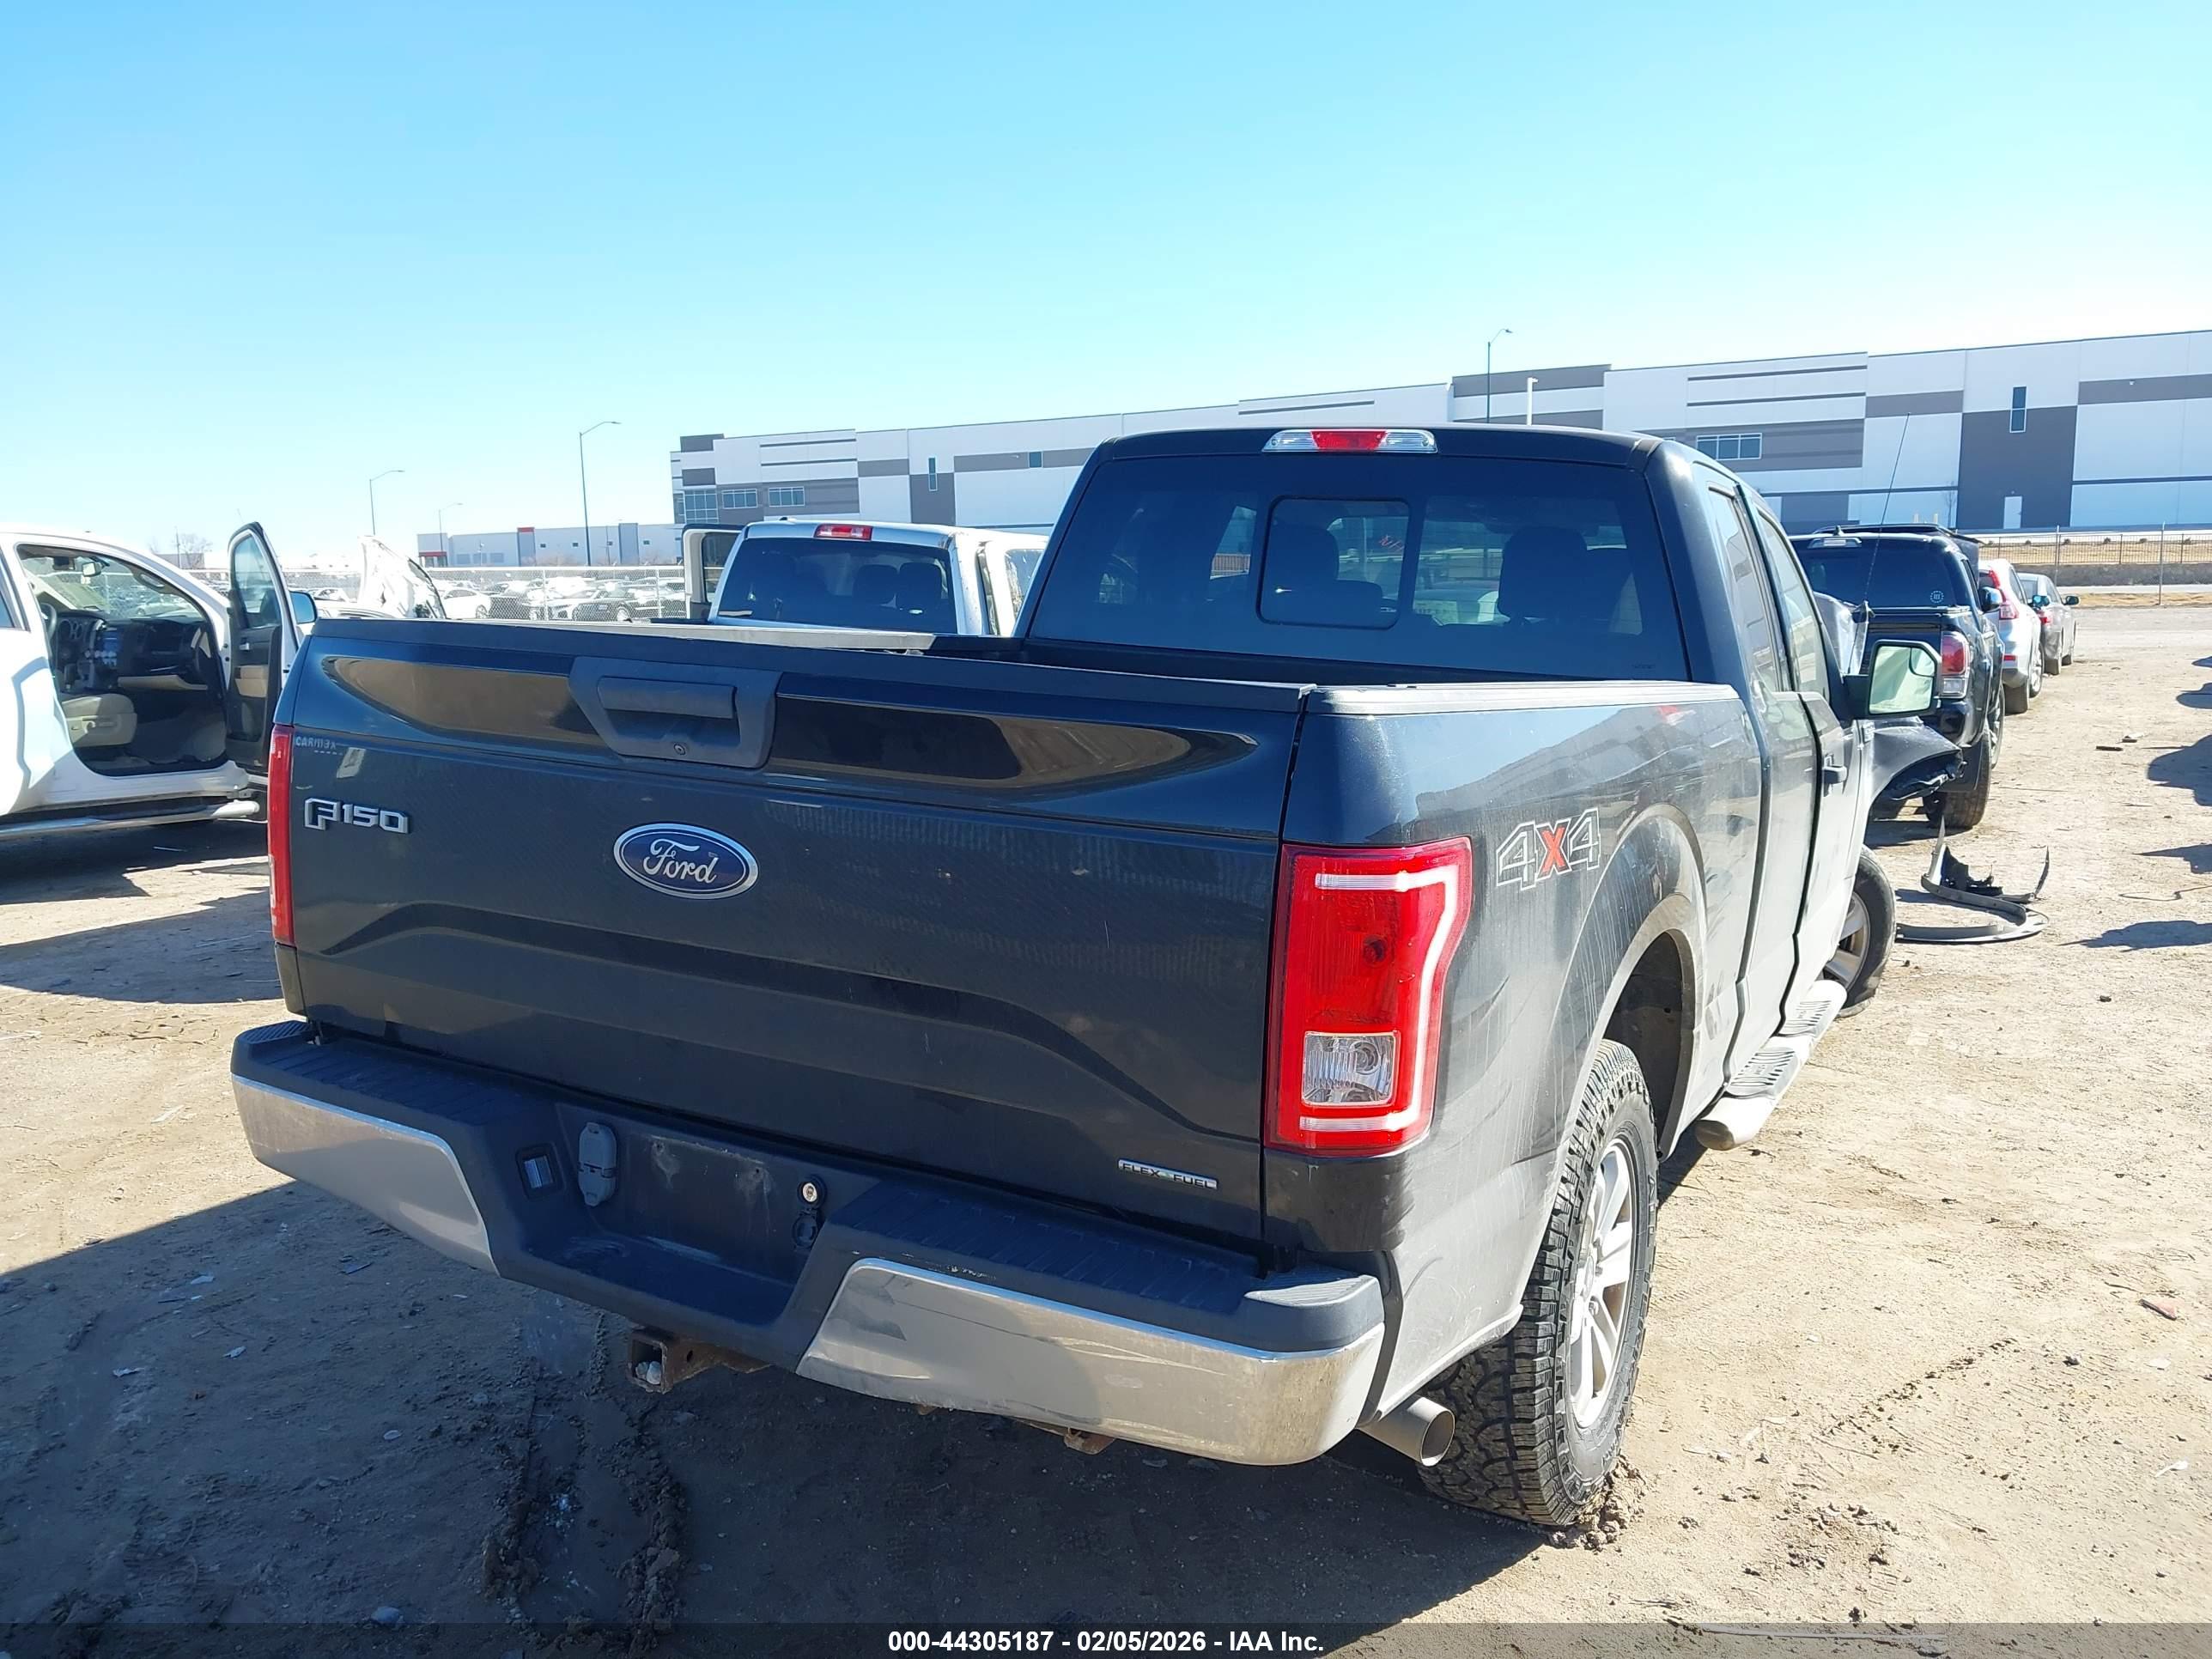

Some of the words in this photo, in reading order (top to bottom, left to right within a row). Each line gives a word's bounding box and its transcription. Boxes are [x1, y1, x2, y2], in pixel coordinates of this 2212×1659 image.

[305, 798, 409, 834] F150
[643, 838, 720, 884] Ford
[1119, 1160, 1161, 1177] FLEX
[1170, 1172, 1218, 1189] FUEL
